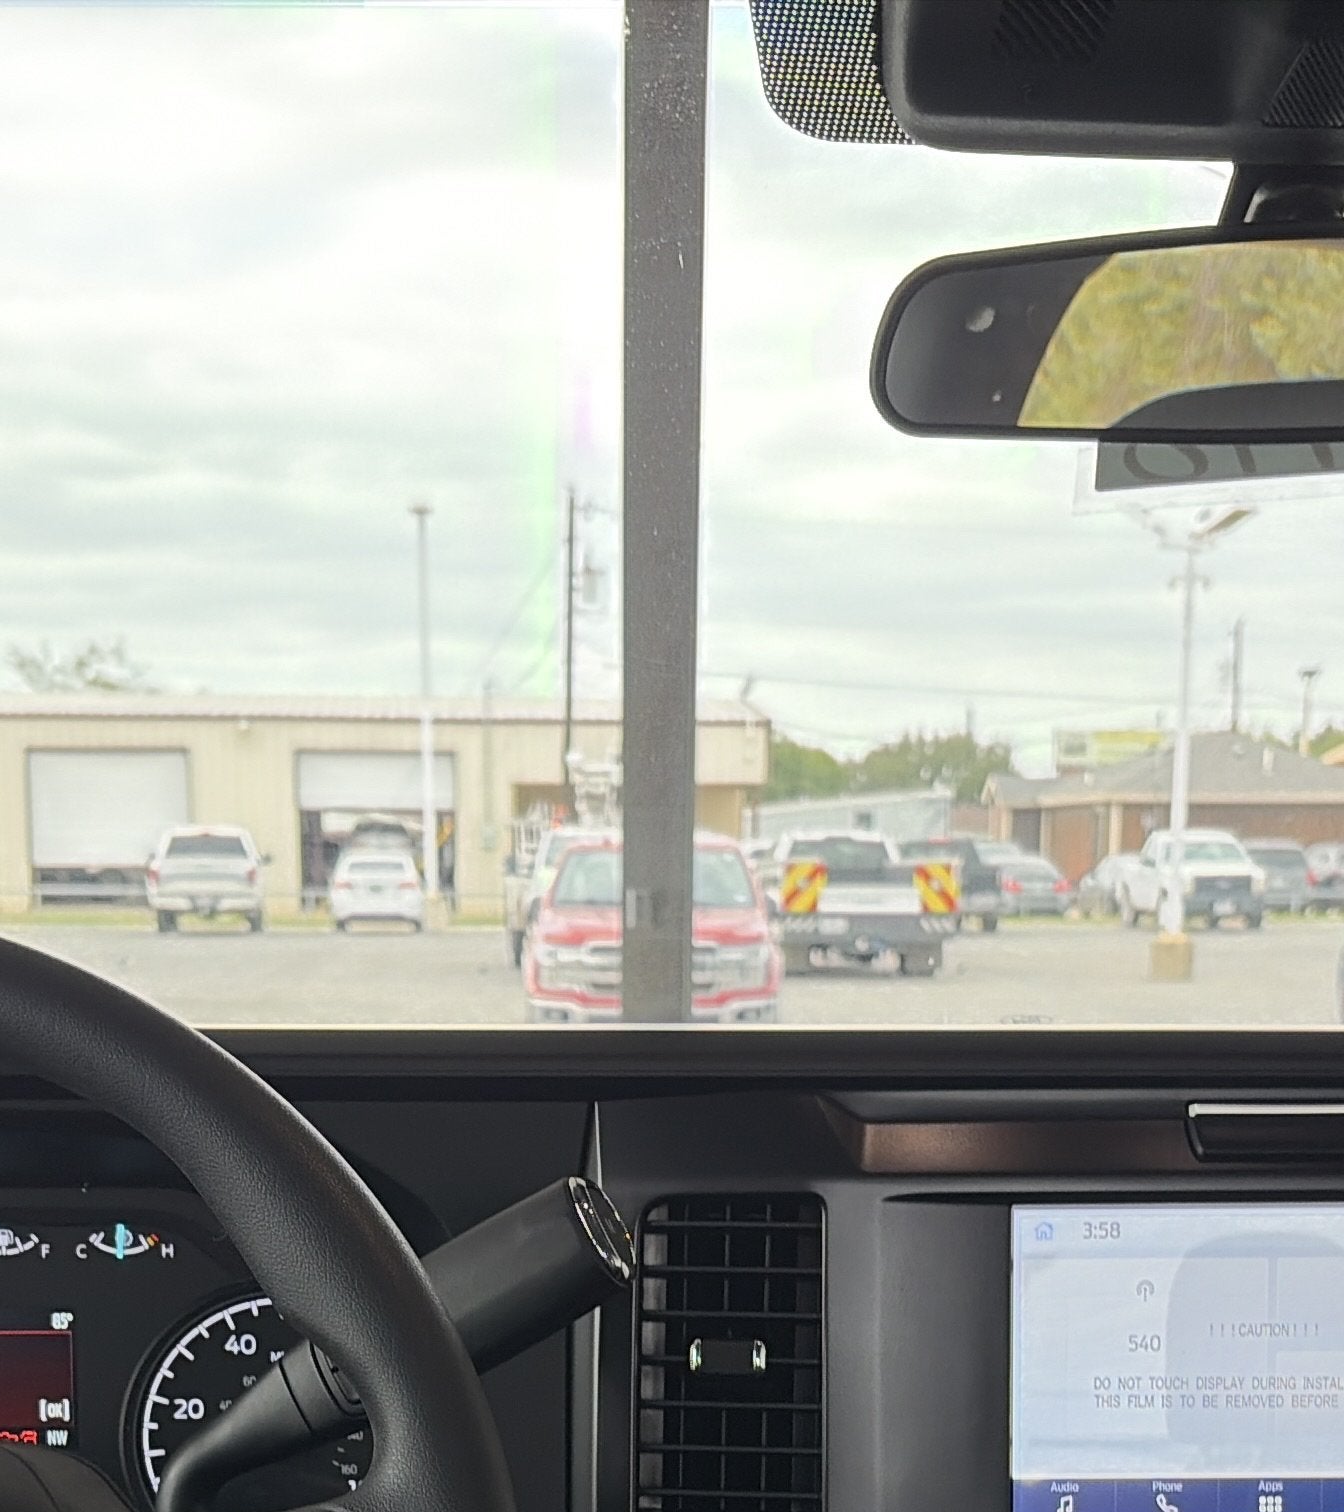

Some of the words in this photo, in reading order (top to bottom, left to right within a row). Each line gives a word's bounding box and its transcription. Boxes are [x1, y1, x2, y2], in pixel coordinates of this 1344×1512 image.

[1082, 1222, 1121, 1240] 3:58
[41, 1244, 50, 1259] F
[76, 1244, 87, 1260] C
[161, 1244, 174, 1260] H
[224, 1333, 257, 1356] 40
[1128, 1334, 1161, 1352] 540
[1093, 1376, 1111, 1391] DO
[1118, 1376, 1142, 1391] NOT
[1148, 1376, 1189, 1391] TOUCH
[1196, 1376, 1245, 1391] DISPLAY
[1252, 1376, 1296, 1391] DURING
[173, 1398, 205, 1419] 20
[1094, 1394, 1121, 1409] THIS
[1127, 1394, 1155, 1409] FILM
[1161, 1394, 1172, 1409] IS
[1178, 1394, 1195, 1409] TO
[1202, 1394, 1219, 1409] BE
[1225, 1394, 1284, 1409] REMOVED
[1291, 1394, 1339, 1409] BEFORE
[46, 1430, 68, 1446] NW
[340, 1463, 358, 1475] 160
[1050, 1480, 1079, 1493] Audio
[1152, 1480, 1183, 1493] Phone
[1258, 1480, 1284, 1495] Apps
